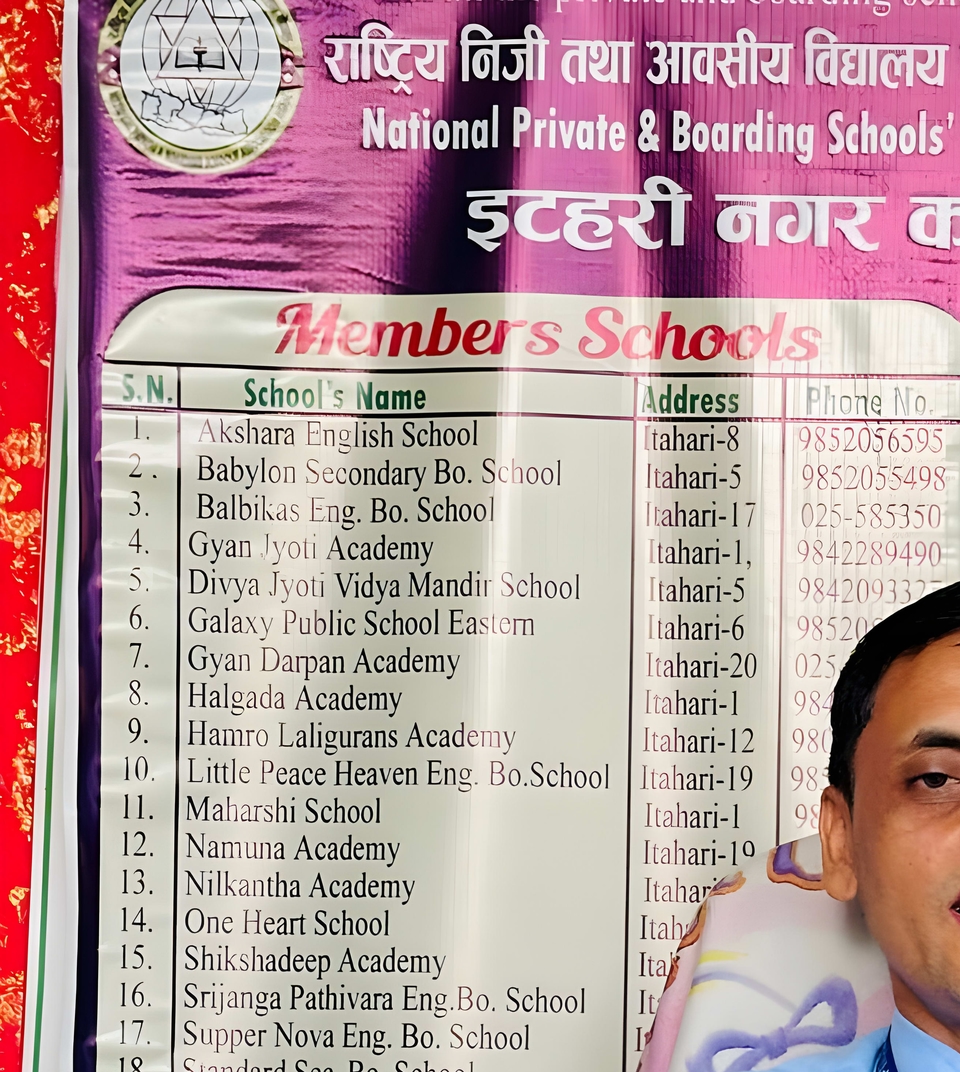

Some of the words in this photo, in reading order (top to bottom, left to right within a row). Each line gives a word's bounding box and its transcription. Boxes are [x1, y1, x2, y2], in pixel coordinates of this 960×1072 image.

[324, 23, 449, 94] राष्ट्रिय
[460, 24, 550, 82] निजी
[561, 40, 634, 84] तथा
[646, 28, 793, 88] आवसीय
[805, 28, 949, 88] विद्यालय
[361, 105, 498, 150] National
[514, 107, 625, 151] Private
[638, 109, 659, 152] &
[673, 109, 816, 164] Boarding
[829, 111, 953, 154] Schools'
[467, 176, 692, 251] इटहरी
[716, 195, 886, 251] नगर
[275, 301, 562, 357] Members
[578, 306, 822, 362] Schools
[122, 375, 173, 405] S.N.
[245, 378, 344, 410] School's
[356, 381, 426, 410] Name
[642, 384, 739, 414] Address
[808, 387, 882, 416] Phone
[894, 387, 933, 415] No.
[198, 418, 295, 447] Akshara
[305, 421, 393, 454] English
[402, 420, 478, 448] School
[644, 425, 739, 452] Itahari-8
[196, 455, 295, 484] Babylon
[306, 459, 427, 492] Secondary
[434, 459, 472, 484] Bo.
[482, 458, 560, 486] School
[647, 464, 741, 490] Itahari-5
[196, 493, 299, 522] Balbikas
[309, 497, 361, 531] Eng.
[370, 498, 408, 523] Bo.
[418, 495, 494, 522] School
[646, 501, 755, 528] Itahari-17
[189, 530, 251, 564] Gyan
[261, 533, 317, 565] Jyoti
[326, 534, 434, 567] Academy
[648, 538, 752, 570] Itahari-1,
[188, 568, 259, 603] Divya
[269, 571, 324, 603] Jyoti
[333, 572, 400, 605] Vidya
[407, 571, 492, 597] Mandir
[501, 572, 580, 599] School
[650, 576, 745, 602] Itahari-5
[188, 607, 273, 641] Galaxy
[283, 609, 356, 636] Public
[364, 609, 439, 636] School
[448, 609, 534, 635] Eastern
[648, 614, 745, 640] Itahari-6
[188, 645, 250, 678] Gyan
[260, 647, 345, 681] Darpan
[352, 647, 460, 680] Academy
[646, 652, 757, 678] Itahari-20
[188, 682, 285, 716] Halgada
[295, 684, 402, 718] Academy
[644, 689, 737, 716] Itahari-1
[188, 720, 268, 747] Hamro
[278, 722, 398, 756] Laligurans
[405, 722, 516, 755] Academy
[643, 727, 755, 753] Itahari-12
[187, 757, 250, 784] Little
[260, 759, 326, 786] Peace
[334, 760, 419, 786] Heaven
[427, 760, 478, 792] Eng.
[640, 765, 753, 791] Itahari-19
[186, 796, 295, 823] Maharshi
[305, 797, 380, 823] School
[644, 802, 740, 828] Itahari-1
[122, 831, 153, 857] 12.
[185, 833, 285, 860] Namuna
[294, 834, 400, 868] Academy
[184, 870, 301, 898] Nilkantha
[308, 872, 415, 905] Academy
[185, 908, 233, 934] One
[242, 909, 307, 935] Heart
[314, 910, 389, 936] School
[121, 944, 152, 970] 15.
[185, 945, 330, 980] Shikshadeep
[337, 947, 446, 980] Academy
[184, 983, 281, 1017] Srijanga
[290, 984, 393, 1010] Pathivara
[506, 987, 585, 1013] School
[183, 1020, 267, 1054] Supper
[273, 1022, 334, 1048] Nova
[342, 1022, 392, 1056] Eng.
[401, 1023, 440, 1049] Bo.
[450, 1023, 529, 1050] School
